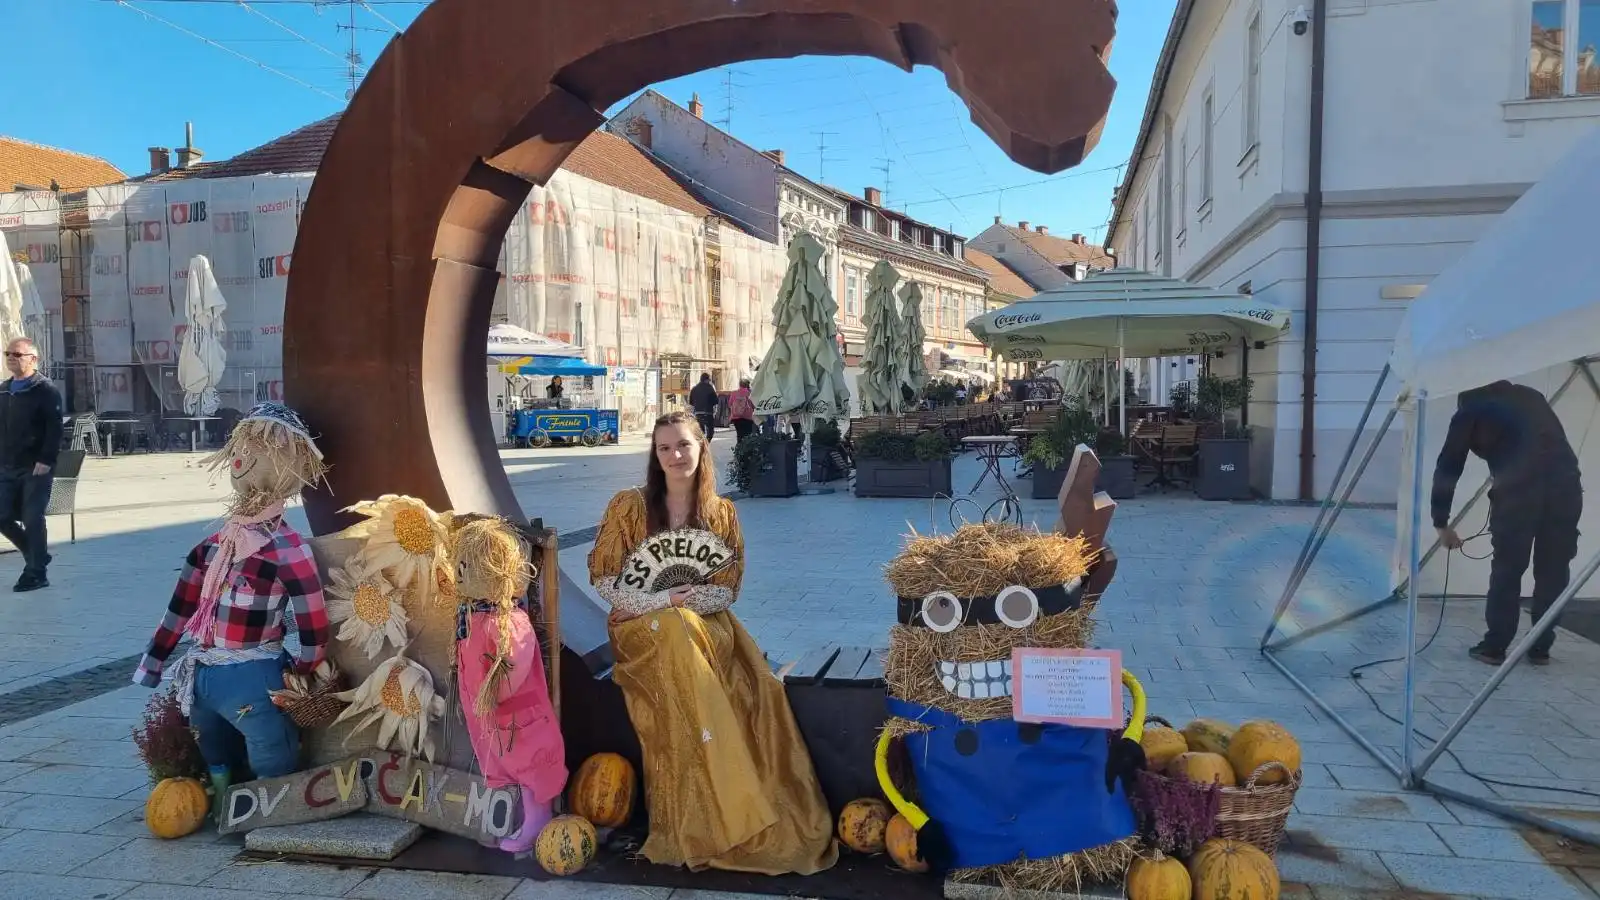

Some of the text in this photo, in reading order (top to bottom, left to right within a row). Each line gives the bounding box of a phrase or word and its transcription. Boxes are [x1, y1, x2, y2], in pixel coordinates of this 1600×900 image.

[188, 201, 207, 222] JUB
[258, 257, 275, 279] JUB
[624, 537, 724, 589] SŠ PRELOG
[228, 783, 290, 827] DV
